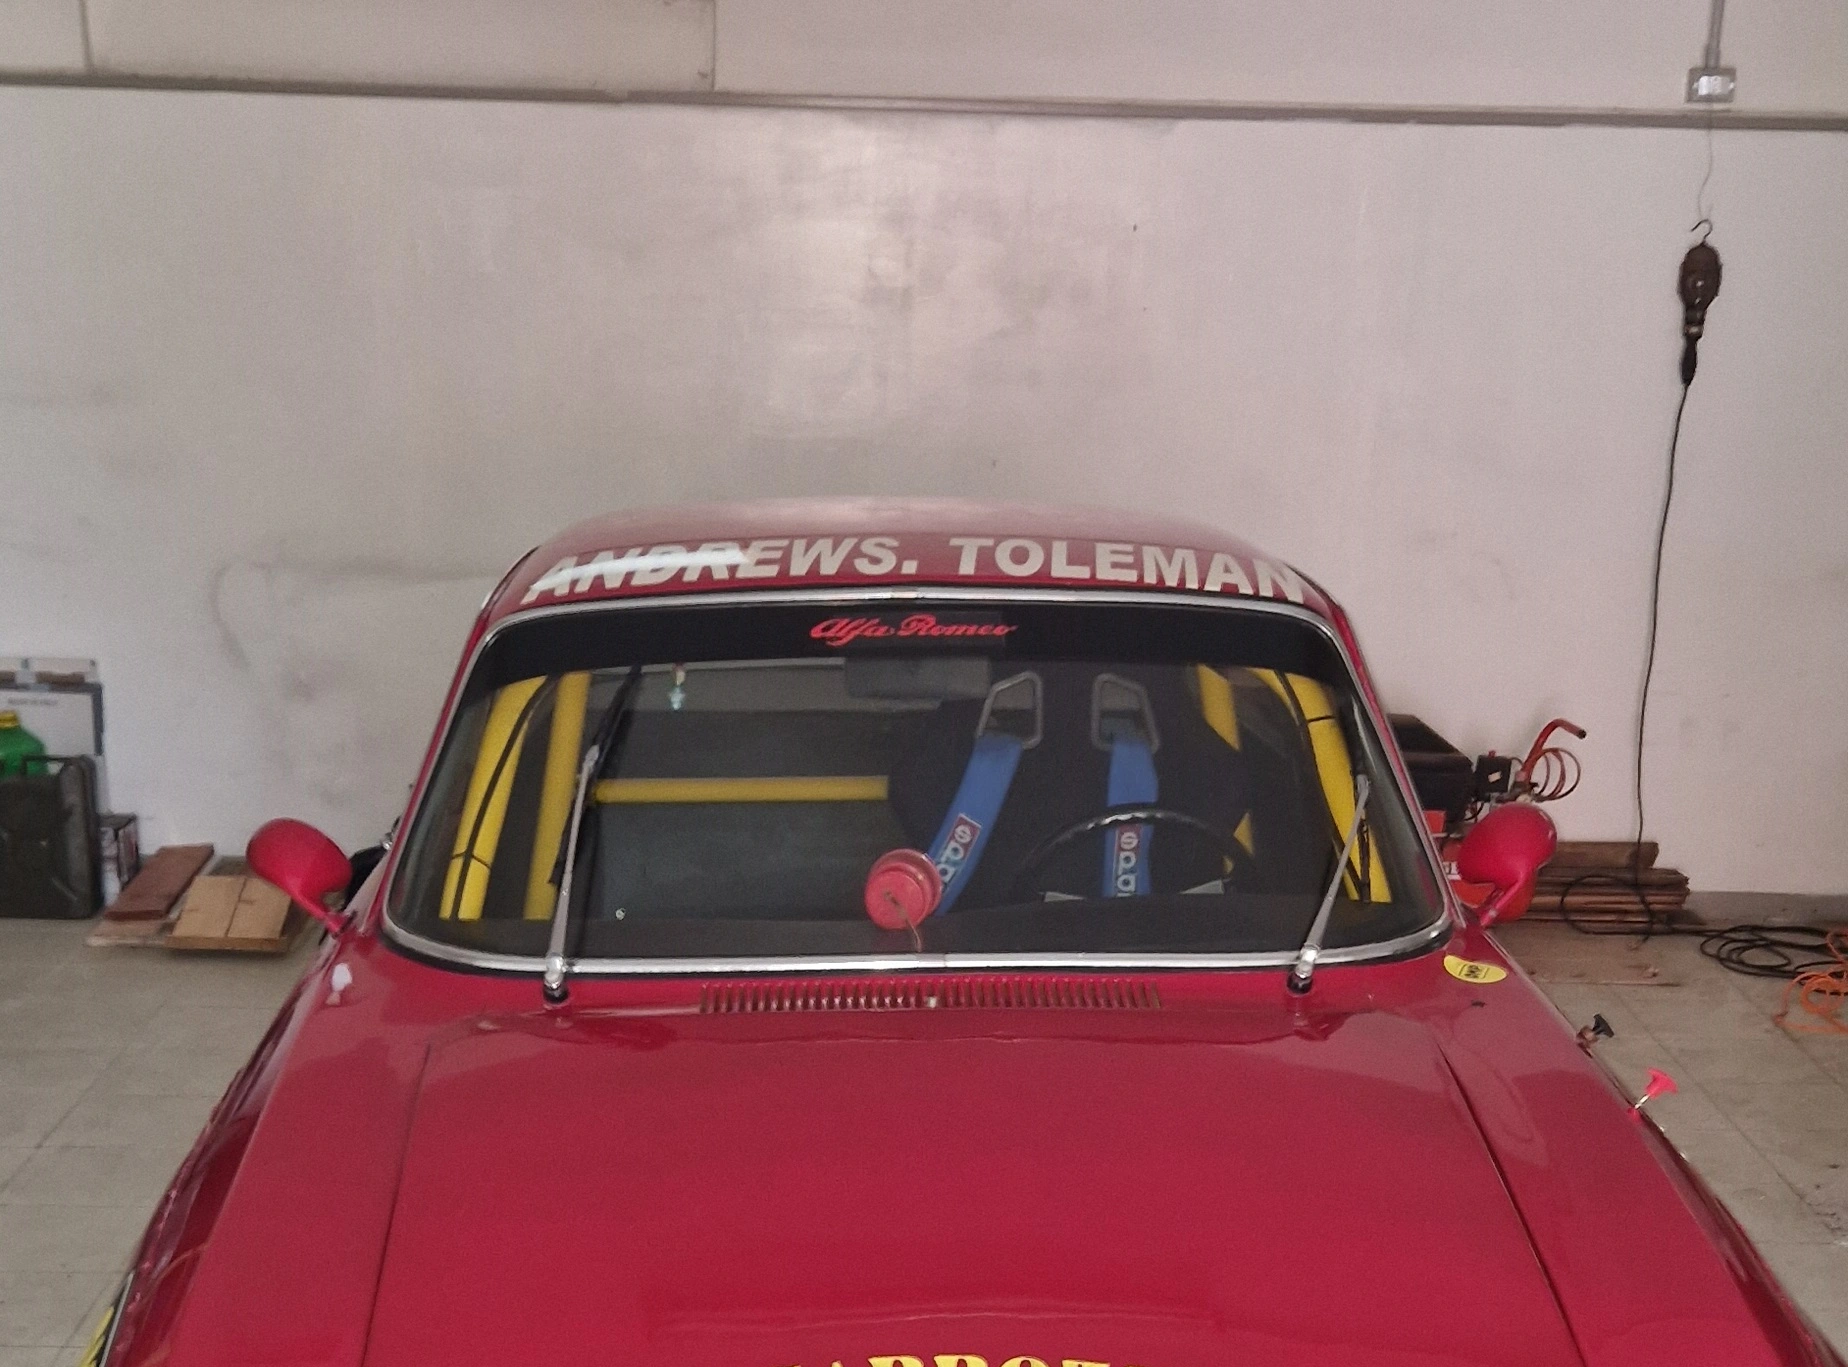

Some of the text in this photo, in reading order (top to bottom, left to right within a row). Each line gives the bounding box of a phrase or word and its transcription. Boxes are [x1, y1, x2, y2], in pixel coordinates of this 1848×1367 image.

[519, 536, 1304, 605] ANDREWS. TOLEMAN
[810, 613, 1019, 647] Alfa Romeo
[935, 823, 974, 892] spa
[1115, 830, 1139, 897] spa
